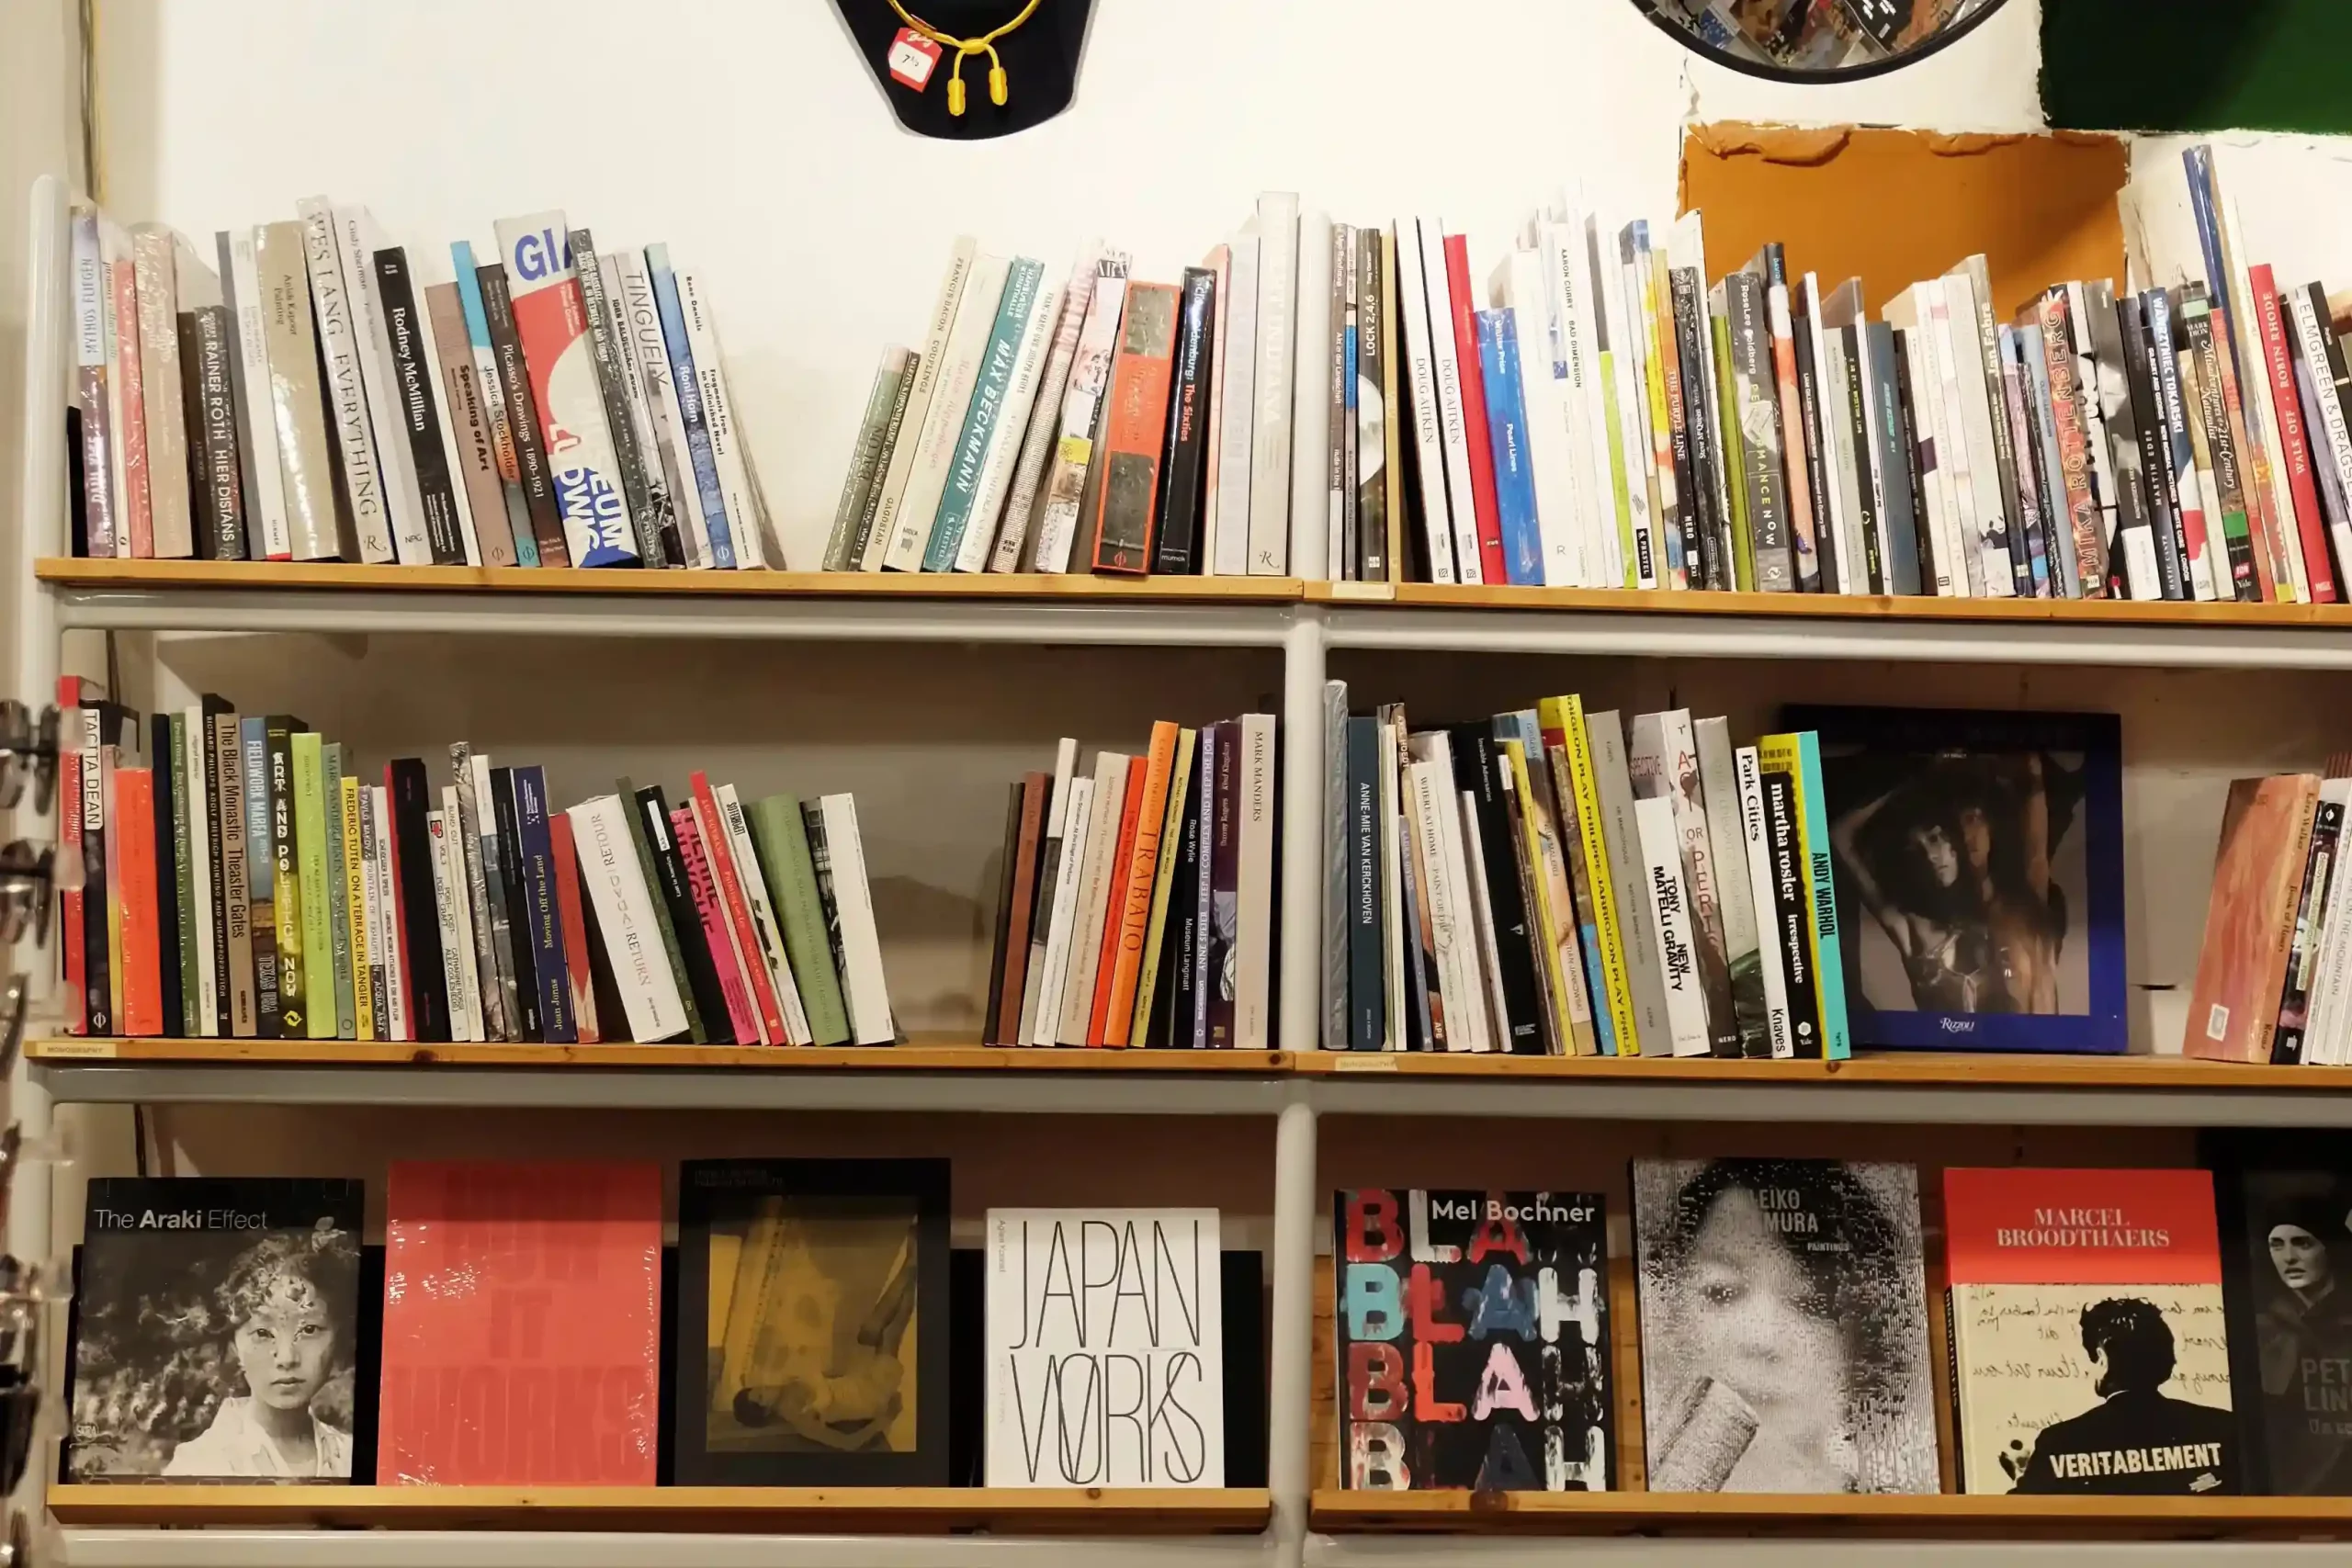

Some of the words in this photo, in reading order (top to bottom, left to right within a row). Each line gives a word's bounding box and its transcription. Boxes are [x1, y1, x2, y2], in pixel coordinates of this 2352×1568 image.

[946, 256, 963, 298] FRANCIS
[1561, 248, 1570, 278] AARON
[1364, 294, 1375, 323] 2,4,6
[1564, 280, 1573, 309] CURRY
[625, 270, 669, 385] TINGUELY
[936, 301, 952, 332] BACON
[1567, 321, 1577, 338] BAD
[1981, 302, 1996, 348] Fabre
[2262, 292, 2280, 341] RHODE
[988, 338, 1011, 379] MAX
[1365, 326, 1375, 355] LOCK
[2300, 303, 2335, 400] ELMGREEN
[2326, 403, 2339, 415] &
[205, 340, 222, 393] RAINER
[391, 307, 411, 359] Rodney
[402, 362, 428, 431] McMillian
[678, 366, 693, 391] Roni
[919, 339, 941, 394] COUPLINGS
[1416, 357, 1429, 393] DOUG
[1441, 358, 1454, 395] DOUG
[1569, 340, 1581, 389] DIMENSION
[1667, 369, 1679, 391] THE
[2271, 344, 2290, 389] ROBIN
[314, 268, 344, 335] LANG
[333, 354, 377, 516] EVERYTHING
[459, 364, 481, 426] Speaking
[683, 394, 699, 423] Horn
[710, 368, 724, 412] Fragments
[1183, 383, 1195, 403] The
[2043, 310, 2088, 491] ROTTENBERG
[2165, 377, 2184, 433] TOKARSKI
[209, 398, 225, 439] ROTH
[483, 366, 500, 407] Jessica
[494, 410, 517, 479] Stockholder
[512, 392, 531, 442] Drawings
[703, 383, 718, 427] Unfinished
[713, 430, 724, 456] Novel
[1179, 406, 1193, 441] Sixties
[1419, 397, 1434, 444] AITKEN
[1445, 398, 1460, 445] AITKEN
[1669, 393, 1683, 433] PURPLE
[1740, 284, 1753, 330] RoseLee
[1762, 509, 1779, 547] NOW
[2283, 409, 2298, 432] OFF
[473, 431, 485, 444] of
[955, 385, 997, 493] BECKMANN
[1673, 434, 1687, 461] LINE
[2288, 432, 2306, 475] WALK
[214, 449, 230, 482] HIER
[476, 446, 491, 472] Art
[874, 496, 894, 546] GAGOSIAN
[1685, 516, 1694, 539] NERO
[2072, 503, 2099, 568] MIKA
[2166, 471, 2177, 502] PICTURES
[2180, 554, 2189, 581] LONDON
[1161, 554, 1186, 563] mumok
[1640, 540, 1650, 575] PRESTEL
[85, 712, 100, 772] TACITA
[220, 723, 237, 747] The
[1396, 715, 1408, 737] AXEL
[1204, 739, 1214, 755] JOB
[1253, 731, 1264, 764] MARK
[1398, 739, 1409, 769] HOEDT
[1477, 738, 1487, 763] Invisible
[208, 753, 217, 788] PHILLIPS
[222, 750, 239, 782] Black
[246, 740, 265, 798] FIELDWORK
[273, 751, 286, 792] ART
[1204, 759, 1213, 775] THE
[1480, 765, 1493, 802] Adversaries
[1741, 754, 1758, 791] Park
[85, 779, 102, 825] DEAN
[1203, 777, 1212, 798] KEEP
[1252, 767, 1263, 821] MANDERS
[1419, 776, 1431, 812] WHERE
[224, 785, 243, 840] Monastic
[250, 802, 266, 838] MARFA
[276, 798, 288, 839] AND
[345, 787, 357, 835] FREDERIC
[1202, 801, 1211, 821] AND
[1361, 783, 1372, 833] ANNE-MIE
[1424, 815, 1433, 826] AT
[1747, 795, 1762, 840] Cities
[1770, 784, 1792, 847] martha
[591, 815, 614, 866] RETOUR
[1188, 819, 1196, 839] Rose
[1201, 825, 1211, 868] COMPLEX
[1361, 836, 1372, 856] VAN
[1426, 829, 1437, 857] HOME
[2296, 817, 2310, 851] Walker
[348, 838, 358, 870] TUTEN
[533, 854, 545, 879] Land
[1186, 840, 1195, 863] Wylie
[1811, 852, 1831, 883] ANDY
[212, 860, 222, 897] PAINTING
[227, 847, 245, 902] Theaster
[350, 875, 359, 891] ON
[537, 886, 547, 897] the
[1123, 827, 1159, 952] TRABAJO
[1200, 881, 1208, 902] KEEP
[1361, 859, 1373, 924] KERCKHOVEN
[1577, 762, 1589, 800] PLAY
[1611, 968, 1623, 1006] PLAY
[1779, 851, 1796, 901] rosler
[230, 905, 247, 939] Gates
[539, 897, 549, 913] Off
[1815, 888, 1837, 940] WARHOL
[352, 903, 364, 948] TERRACE
[541, 915, 555, 949] Moving
[1182, 919, 1193, 951] Museum
[1653, 865, 1669, 926] MATELLI
[1663, 930, 1683, 991] GRAVITY
[1666, 875, 1680, 913] TONY
[1677, 943, 1690, 975] NEW
[356, 951, 366, 962] IN
[625, 932, 651, 986] RETURN
[1198, 945, 1206, 971] ANNE
[1787, 914, 1805, 984] irrespective
[258, 956, 275, 990] TEXAS
[285, 956, 297, 998] NOW
[356, 964, 368, 1007] TANGIER
[1181, 954, 1191, 990] Langmatt
[2330, 941, 2347, 996] MOUNTAIN
[261, 992, 277, 1013] USA
[549, 978, 560, 1005] Jonas
[553, 1008, 562, 1031] Joan
[1434, 1021, 1443, 1039] APE
[1771, 1008, 1787, 1053] Knaves
[1718, 1035, 1736, 1043] NERO
[1431, 1199, 1476, 1221] Mel
[1486, 1199, 1596, 1224] Bochner
[1752, 1189, 1801, 1210] EIKO
[2033, 1208, 2131, 1227] MARCEL
[95, 1209, 134, 1229] The
[140, 1208, 202, 1229] Araki
[208, 1209, 267, 1229] Effect
[1996, 1228, 2170, 1247] BROODTHAERS
[1009, 1219, 1201, 1350] JAPAN
[1345, 1263, 1600, 1343] BLAH
[1349, 1342, 1605, 1423] BLAH
[2301, 1358, 2352, 1383] PET
[2302, 1385, 2352, 1412] LIN
[1011, 1352, 1205, 1484] WORKS
[2050, 1442, 2222, 1479] VERITABLEMENT
